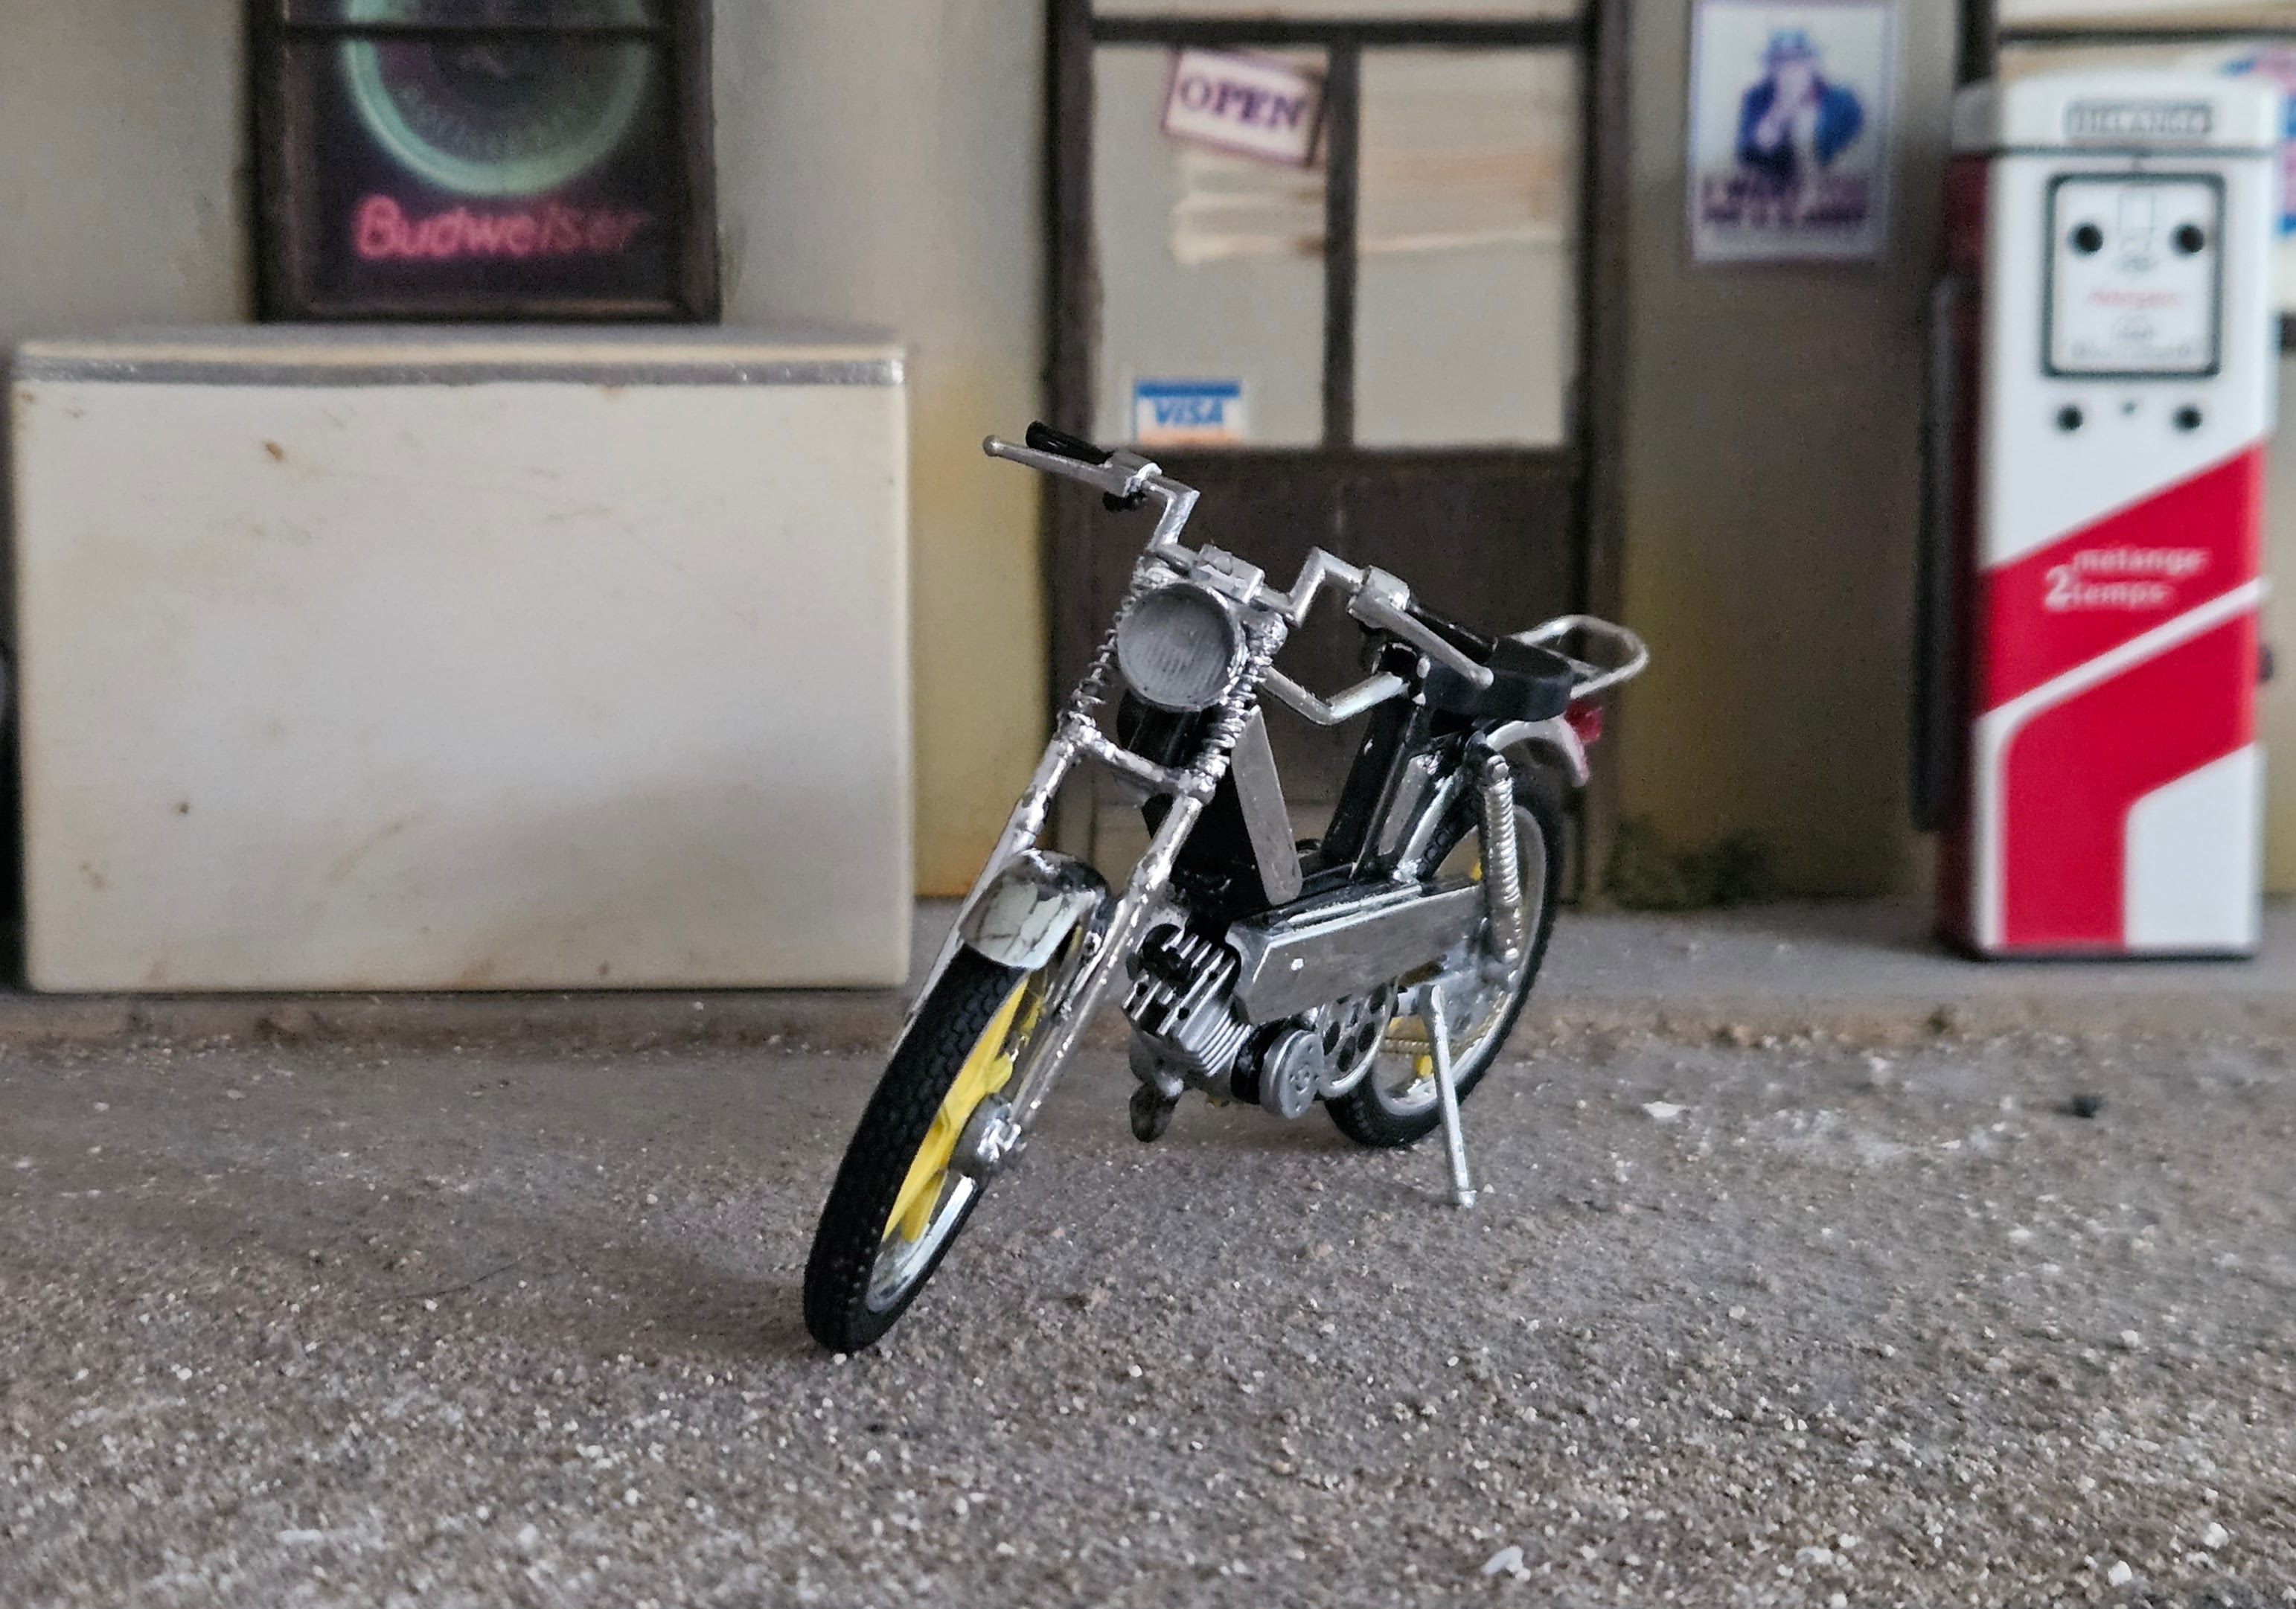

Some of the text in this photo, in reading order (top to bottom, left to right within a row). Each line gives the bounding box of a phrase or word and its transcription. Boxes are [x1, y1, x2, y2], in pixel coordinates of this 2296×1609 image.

[1178, 75, 1307, 130] OPEN
[353, 193, 649, 258] Budweiser
[1154, 397, 1223, 426] VISA
[2044, 563, 2071, 612] 2
